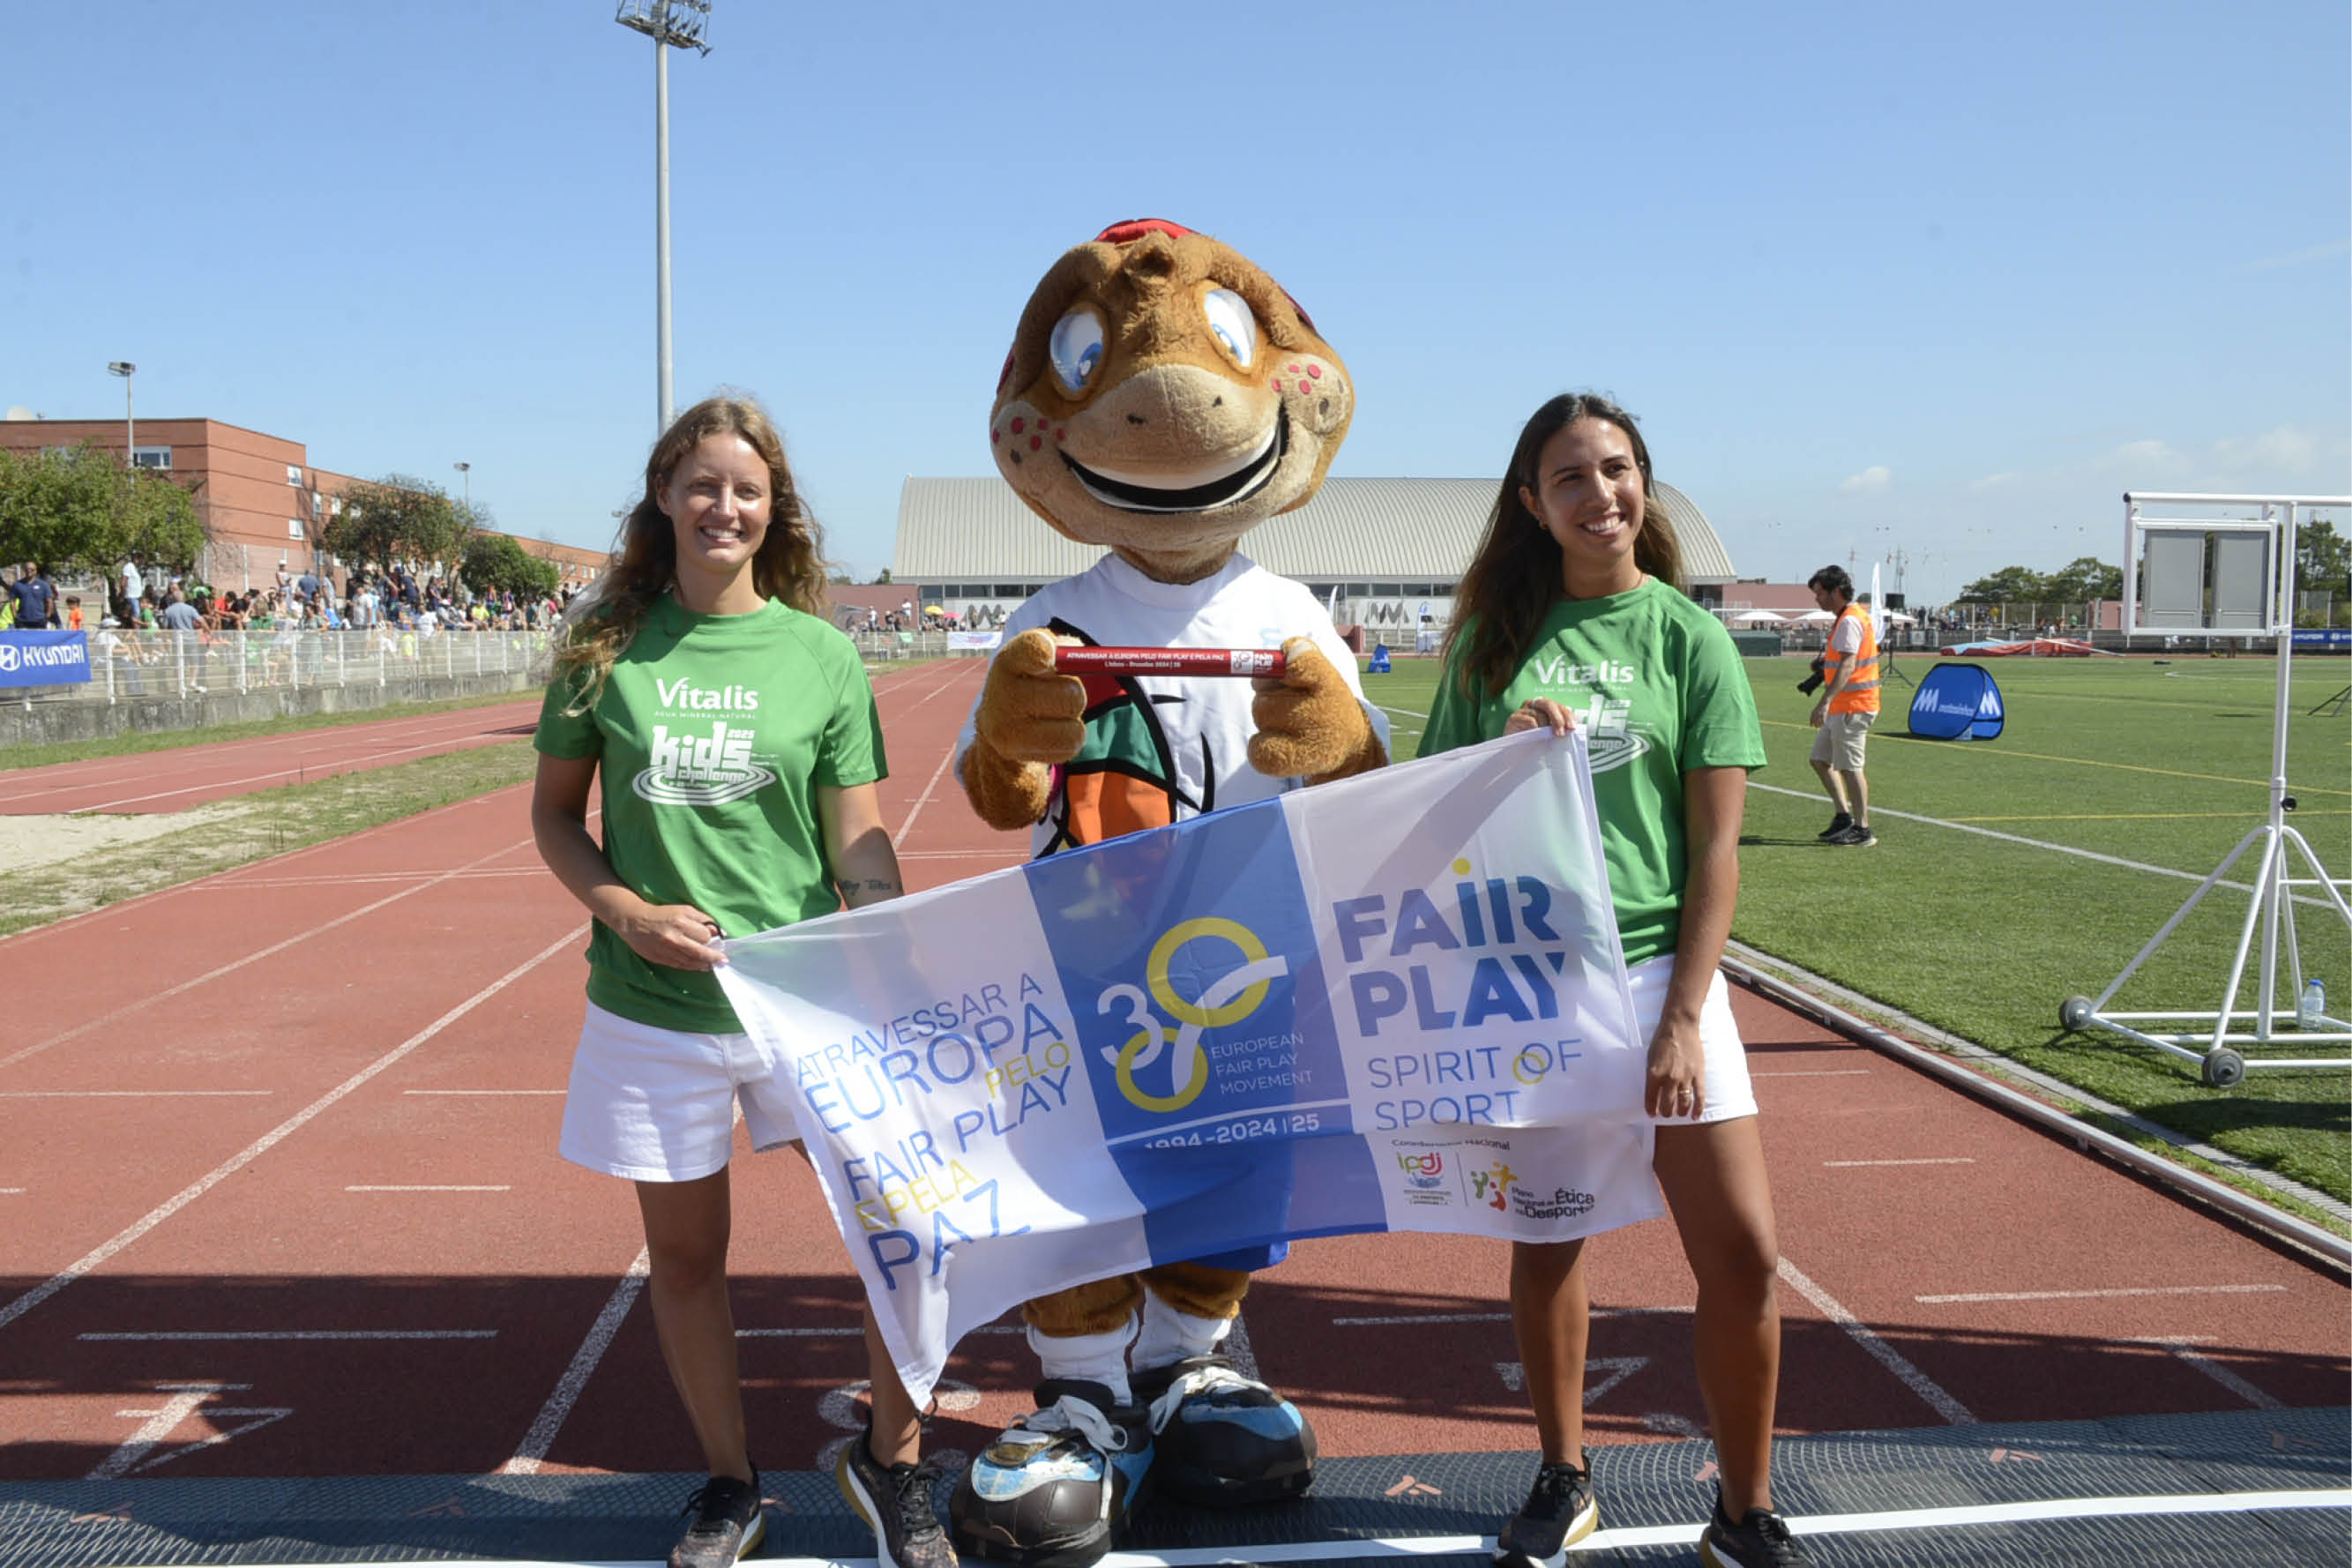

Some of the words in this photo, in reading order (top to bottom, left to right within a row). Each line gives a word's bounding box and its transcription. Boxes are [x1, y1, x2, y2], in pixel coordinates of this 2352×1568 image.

[22, 644, 86, 667] HYUNDAI
[1534, 653, 1635, 685] Vitalis
[655, 676, 759, 711] Vitalis
[651, 721, 752, 779] kids
[1333, 857, 1562, 964] FAIR
[1349, 952, 1565, 1037] PLAY
[796, 982, 1009, 1087] ATRAVESSAR
[1019, 973, 1043, 1003] A
[1210, 1032, 1304, 1059] EUROPEAN
[803, 1002, 1064, 1135] EUROPA
[984, 1042, 1071, 1099] PELO
[1215, 1059, 1255, 1078] FAIR
[1256, 1052, 1299, 1071] PLAY
[1220, 1070, 1312, 1095] MOVEMENT
[1368, 1046, 1502, 1089] SPIRIT
[1519, 1038, 1583, 1076] OF
[843, 1130, 945, 1202] FAIR
[953, 1064, 1071, 1154] PLAY
[1375, 1090, 1520, 1131] SPORT
[1555, 1187, 1595, 1206] Ética
[868, 1177, 1032, 1291] PAZ
